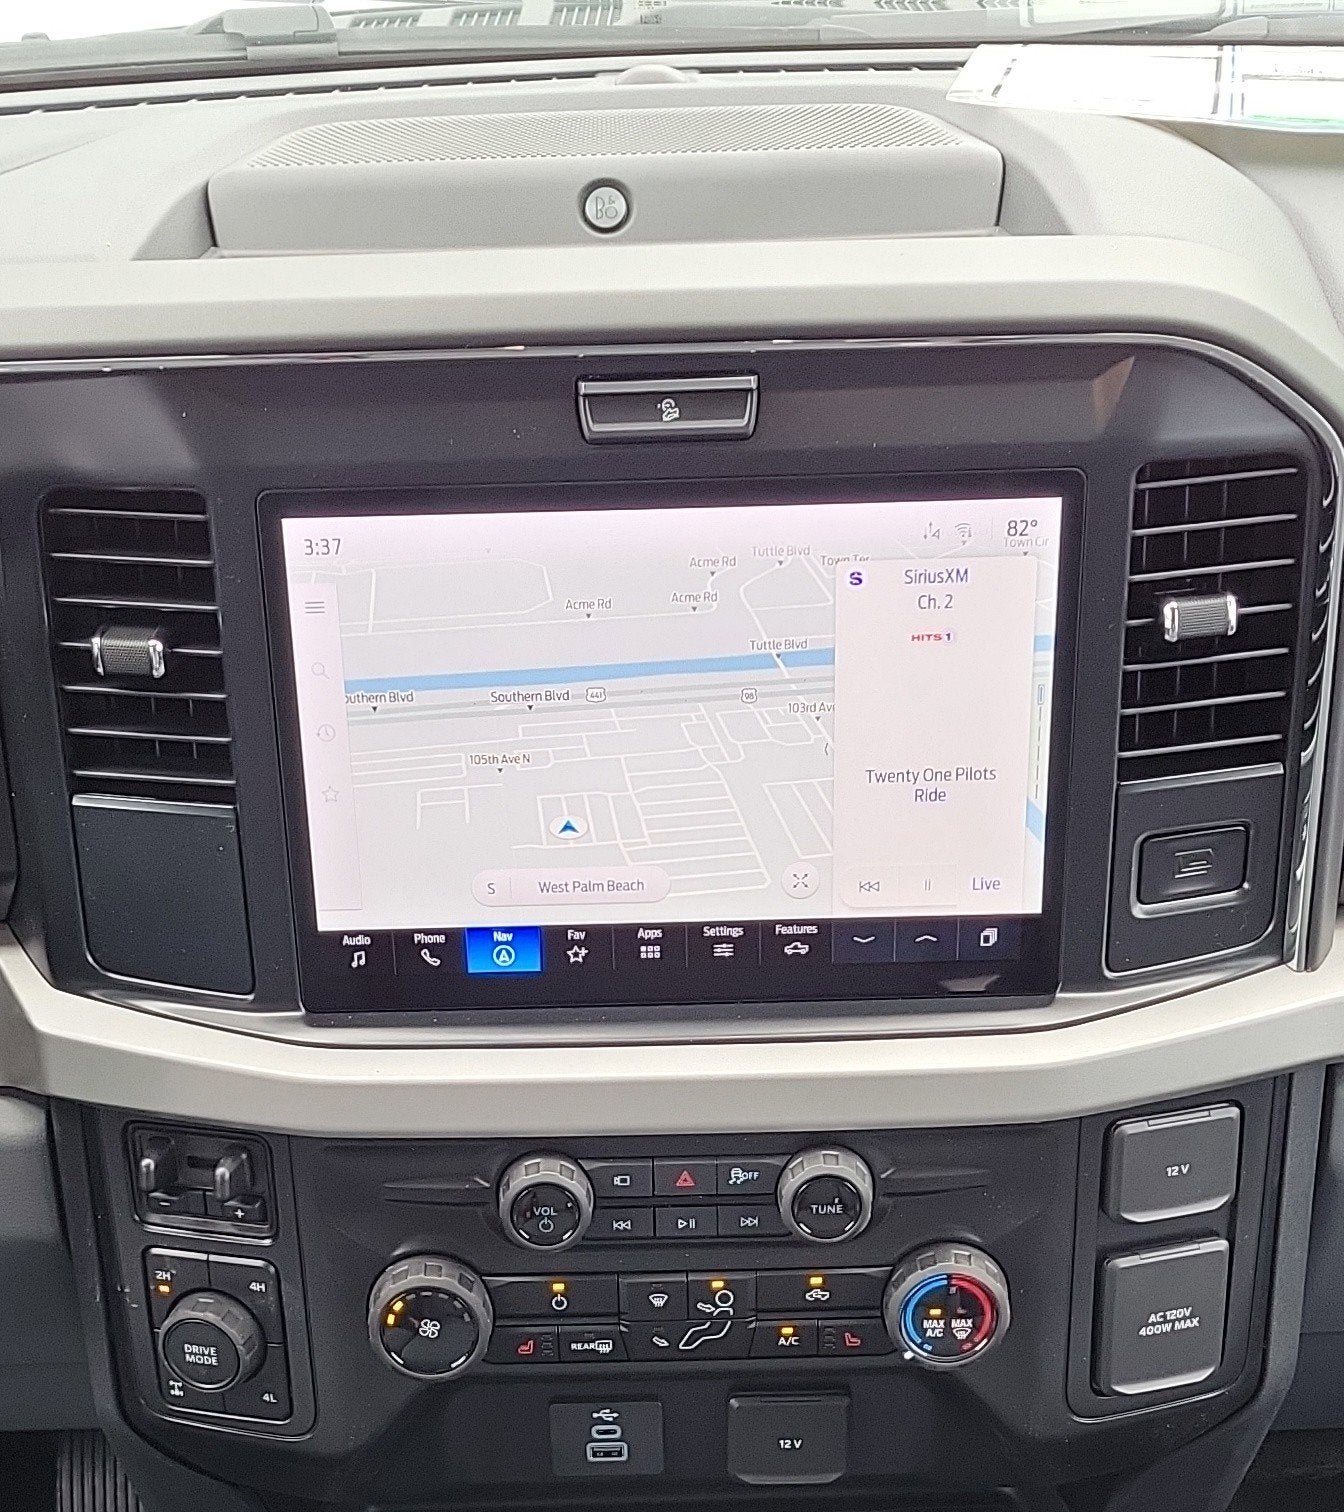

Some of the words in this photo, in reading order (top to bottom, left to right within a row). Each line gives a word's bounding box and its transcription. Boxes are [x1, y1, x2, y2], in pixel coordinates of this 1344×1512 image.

[304, 538, 341, 556] 3:37
[1005, 537, 1032, 547] Town
[752, 546, 784, 557] Tuttle
[786, 546, 810, 556] Blvd
[690, 557, 720, 567] Acme
[722, 556, 736, 566] Rd
[904, 569, 968, 584] SiriusXM
[671, 592, 701, 603] Acme
[703, 592, 718, 602] Rd
[918, 595, 940, 609] Ch.
[945, 595, 953, 609] 2
[566, 598, 595, 610] Acme
[597, 598, 612, 609] Rd
[945, 633, 951, 641] 1
[750, 639, 782, 649] Tuttle
[784, 639, 808, 649] Blvd
[346, 692, 387, 704] outhern
[389, 691, 414, 703] Blvd
[491, 691, 542, 703] Southern
[545, 690, 570, 701] Blvd
[590, 691, 602, 699] 441
[788, 702, 816, 713] 103rd
[469, 754, 499, 765] 105th
[501, 754, 520, 764] Ave
[522, 754, 530, 763] N
[866, 769, 919, 785] Twenty
[923, 768, 951, 782] One
[956, 767, 997, 782] Pilots
[915, 788, 946, 803] Ride
[487, 883, 495, 895] S
[539, 882, 569, 894] West
[573, 880, 604, 892] Palm
[608, 879, 644, 892] Beach
[972, 877, 1001, 891] Live
[567, 929, 586, 941] Fav
[637, 927, 663, 941] Apps
[703, 925, 744, 938] Settings
[775, 923, 818, 936] Features
[343, 934, 371, 946] Audio
[414, 932, 446, 944] Phone
[493, 931, 513, 942] Nav
[742, 1170, 760, 1180] OFF
[1166, 1166, 1179, 1177] 12
[1180, 1163, 1190, 1174] V
[534, 1207, 557, 1217] VOL
[811, 1204, 843, 1215] TUNE
[155, 1271, 171, 1280] 2H
[249, 1282, 266, 1292] 4H
[1148, 1311, 1164, 1323] AC
[1166, 1307, 1192, 1320] 120V
[923, 1320, 945, 1328] MAX
[951, 1319, 973, 1327] MAX
[1139, 1321, 1173, 1336] 400W
[1174, 1317, 1199, 1331] MAX
[926, 1329, 944, 1337] A/C
[778, 1335, 800, 1346] A/C
[184, 1344, 217, 1356] DRIVE
[571, 1341, 596, 1352] REAR
[185, 1353, 219, 1366] MODE
[262, 1393, 277, 1402] 4L
[779, 1439, 792, 1449] 12
[794, 1439, 802, 1449] V
